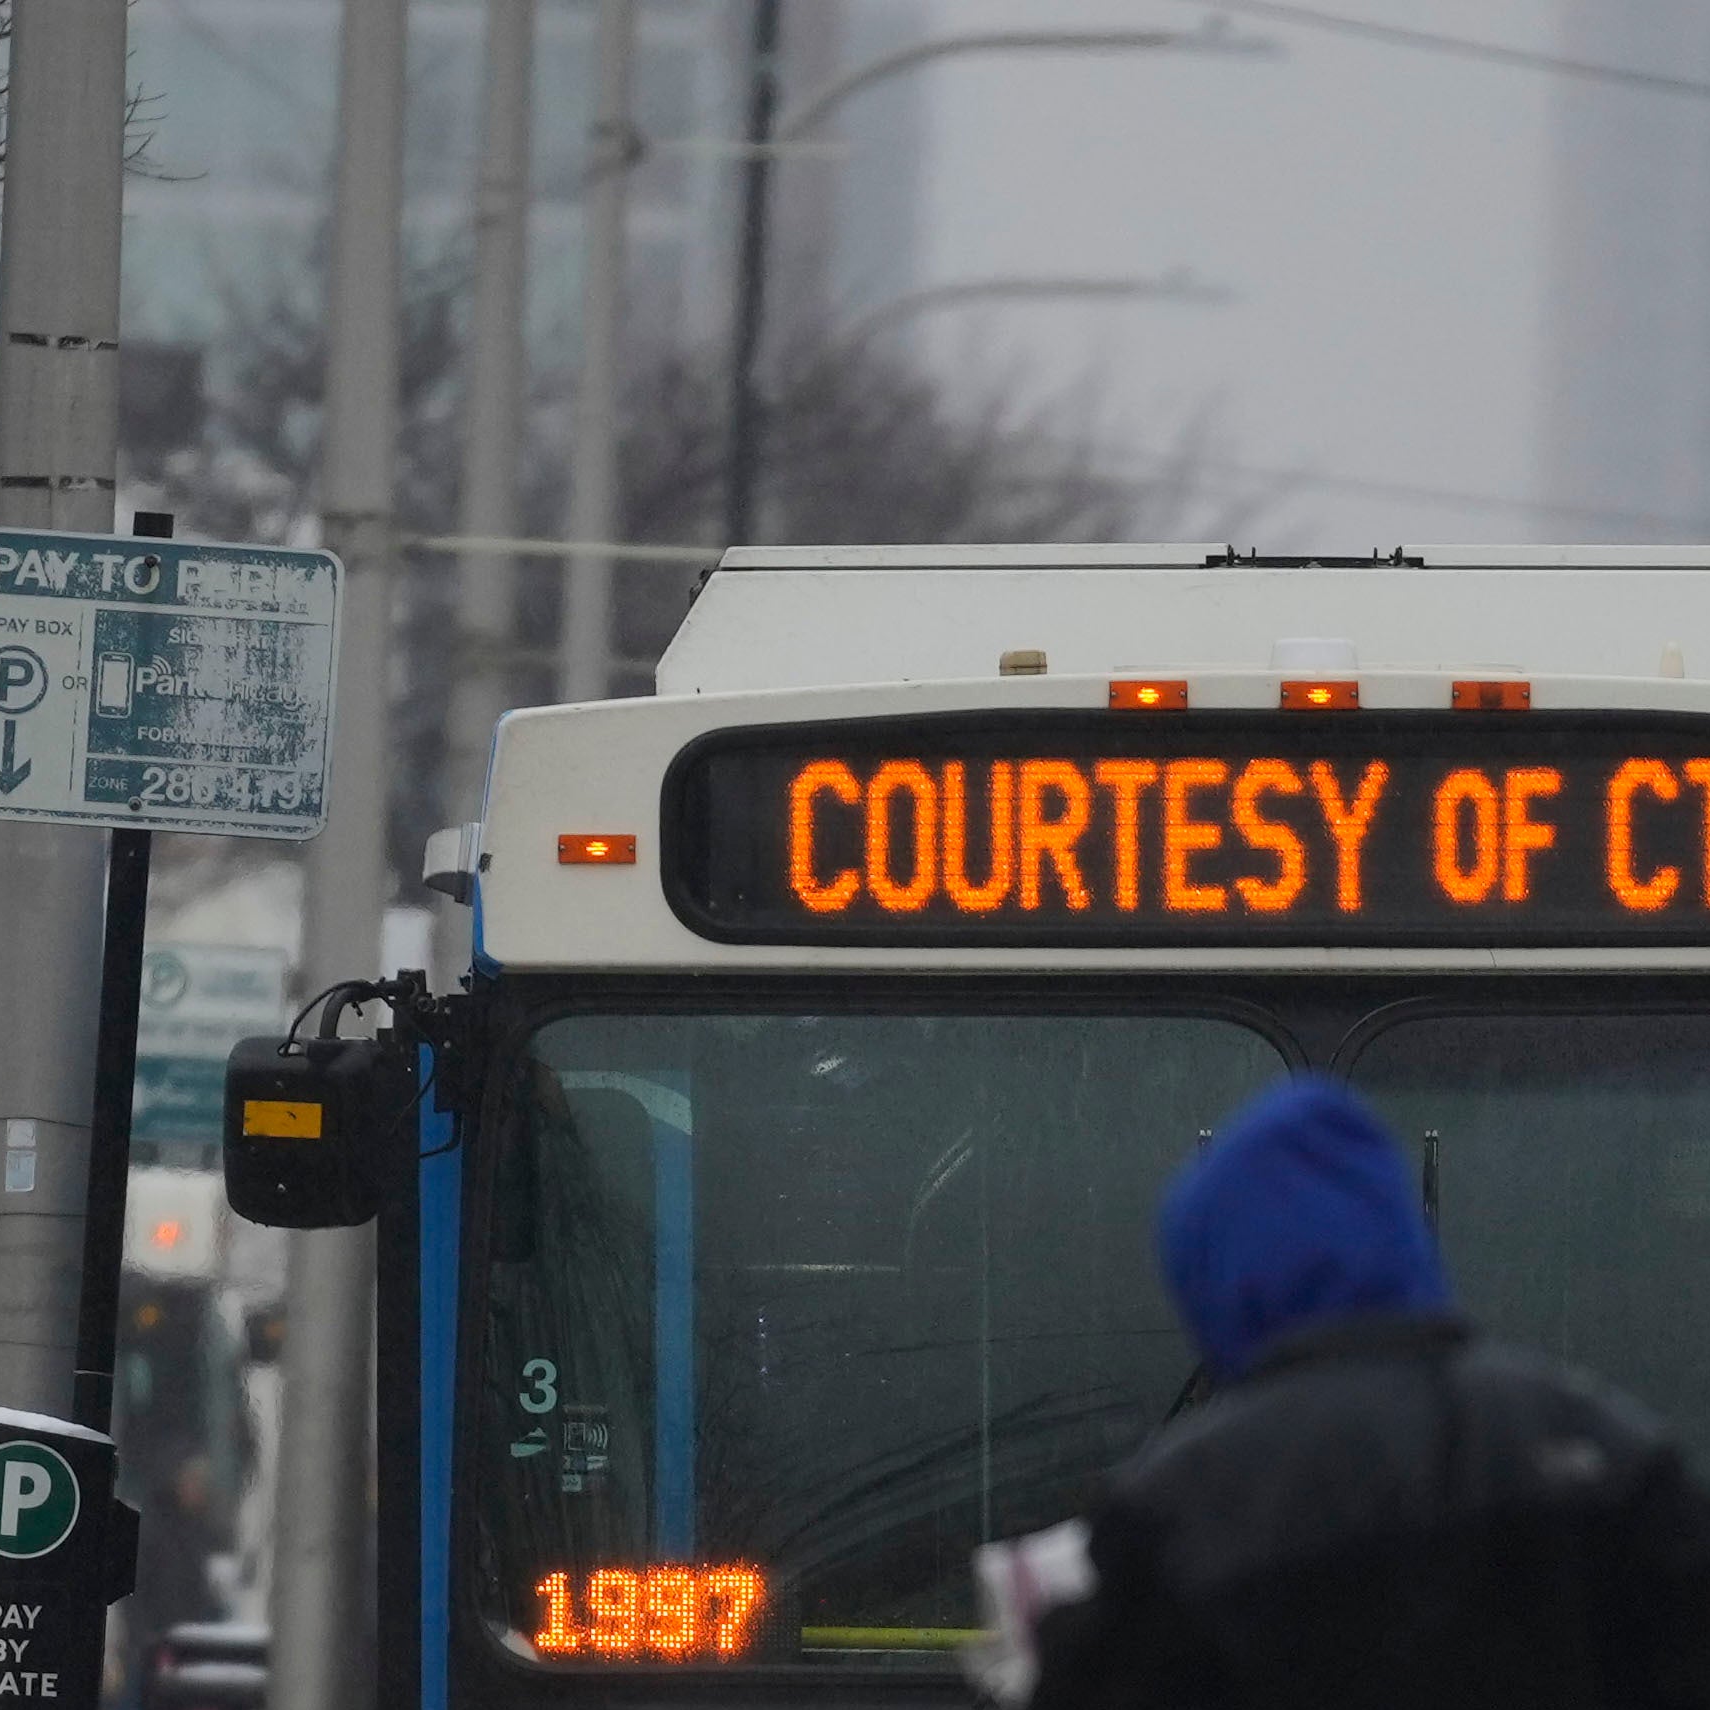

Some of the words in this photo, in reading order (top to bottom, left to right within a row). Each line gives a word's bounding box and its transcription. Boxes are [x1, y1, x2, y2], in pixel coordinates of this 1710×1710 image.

[92, 550, 160, 595] TO
[35, 619, 74, 636] BOX
[62, 674, 89, 692] OR
[88, 775, 129, 791] ZONE
[790, 757, 1390, 913] COURTESY
[1432, 765, 1564, 906] OF
[519, 1358, 558, 1414] 3
[0, 1460, 52, 1537] P
[536, 1569, 758, 1654] 1997
